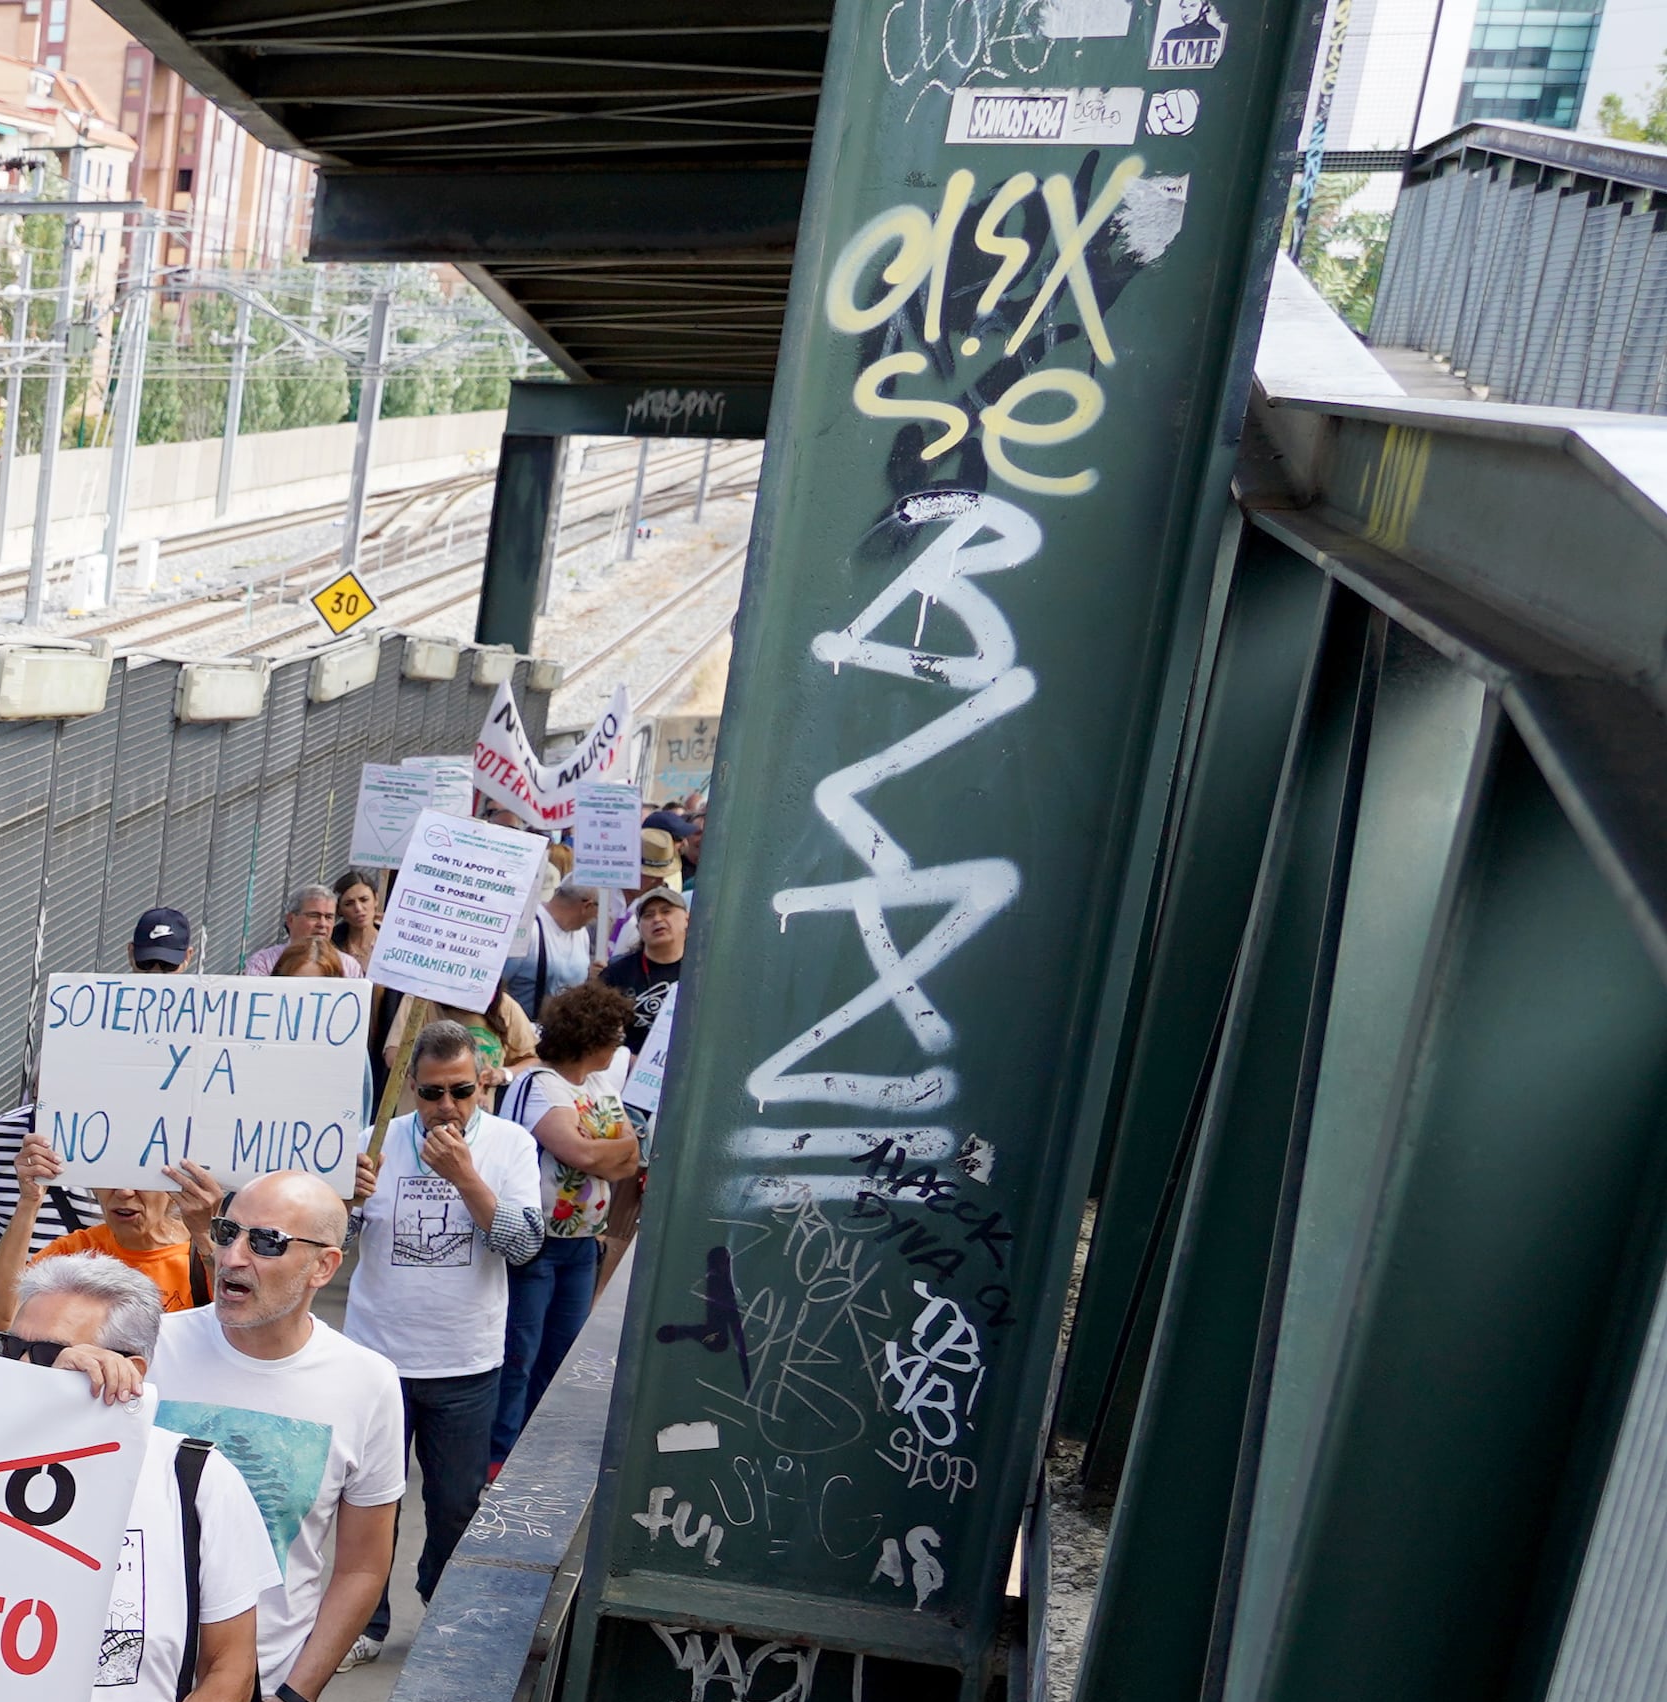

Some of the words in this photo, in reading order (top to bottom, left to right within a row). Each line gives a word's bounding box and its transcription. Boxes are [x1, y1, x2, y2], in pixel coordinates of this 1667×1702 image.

[1154, 38, 1219, 67] ACME
[970, 98, 1068, 138] SOMOS1984
[331, 590, 359, 616] 30
[557, 714, 617, 788] MURO
[413, 863, 461, 883] SOTERRAMIENTO
[463, 876, 473, 887] DEL
[432, 853, 450, 863] CON
[451, 858, 463, 867] TU
[464, 862, 495, 875] APOYO
[497, 868, 507, 878] EL
[434, 884, 445, 893] ES
[447, 887, 485, 903] POSIBLE
[406, 895, 416, 906] TU
[419, 898, 440, 913] FIRMA
[444, 904, 453, 916] ES
[457, 906, 503, 928] IMPORTANTE
[394, 917, 405, 926] LOS
[434, 928, 443, 936] NO
[446, 930, 457, 939] SON
[460, 933, 467, 942] LA
[398, 931, 433, 946] VALLADOLID
[48, 980, 362, 1046] SOTERRAMIENTO
